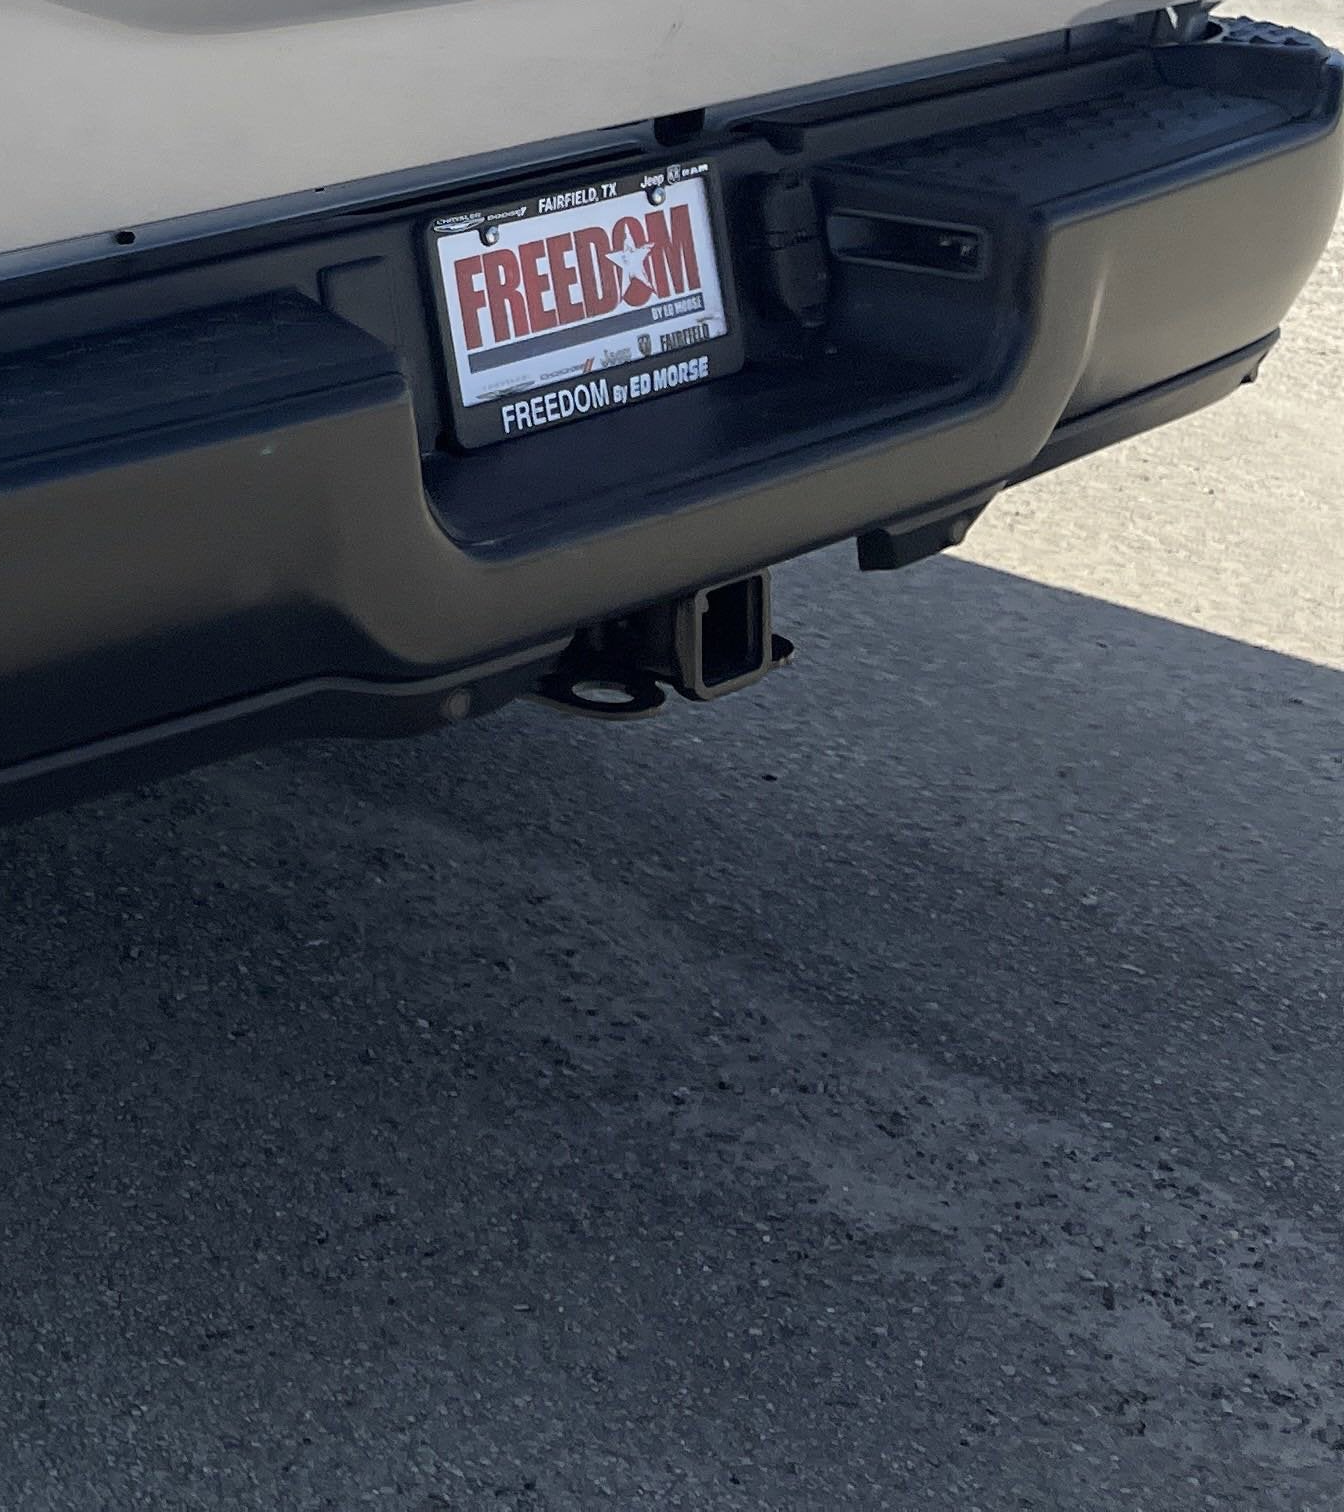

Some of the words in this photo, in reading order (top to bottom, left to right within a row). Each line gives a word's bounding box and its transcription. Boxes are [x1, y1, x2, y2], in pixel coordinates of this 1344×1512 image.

[537, 185, 601, 214] FAIRFIELD,
[600, 181, 618, 200] TX
[639, 173, 665, 190] Jeep
[454, 203, 702, 351] FREEDOM
[501, 378, 611, 434] FREEDOM
[629, 372, 652, 399] ED
[652, 355, 710, 393] MORSE
